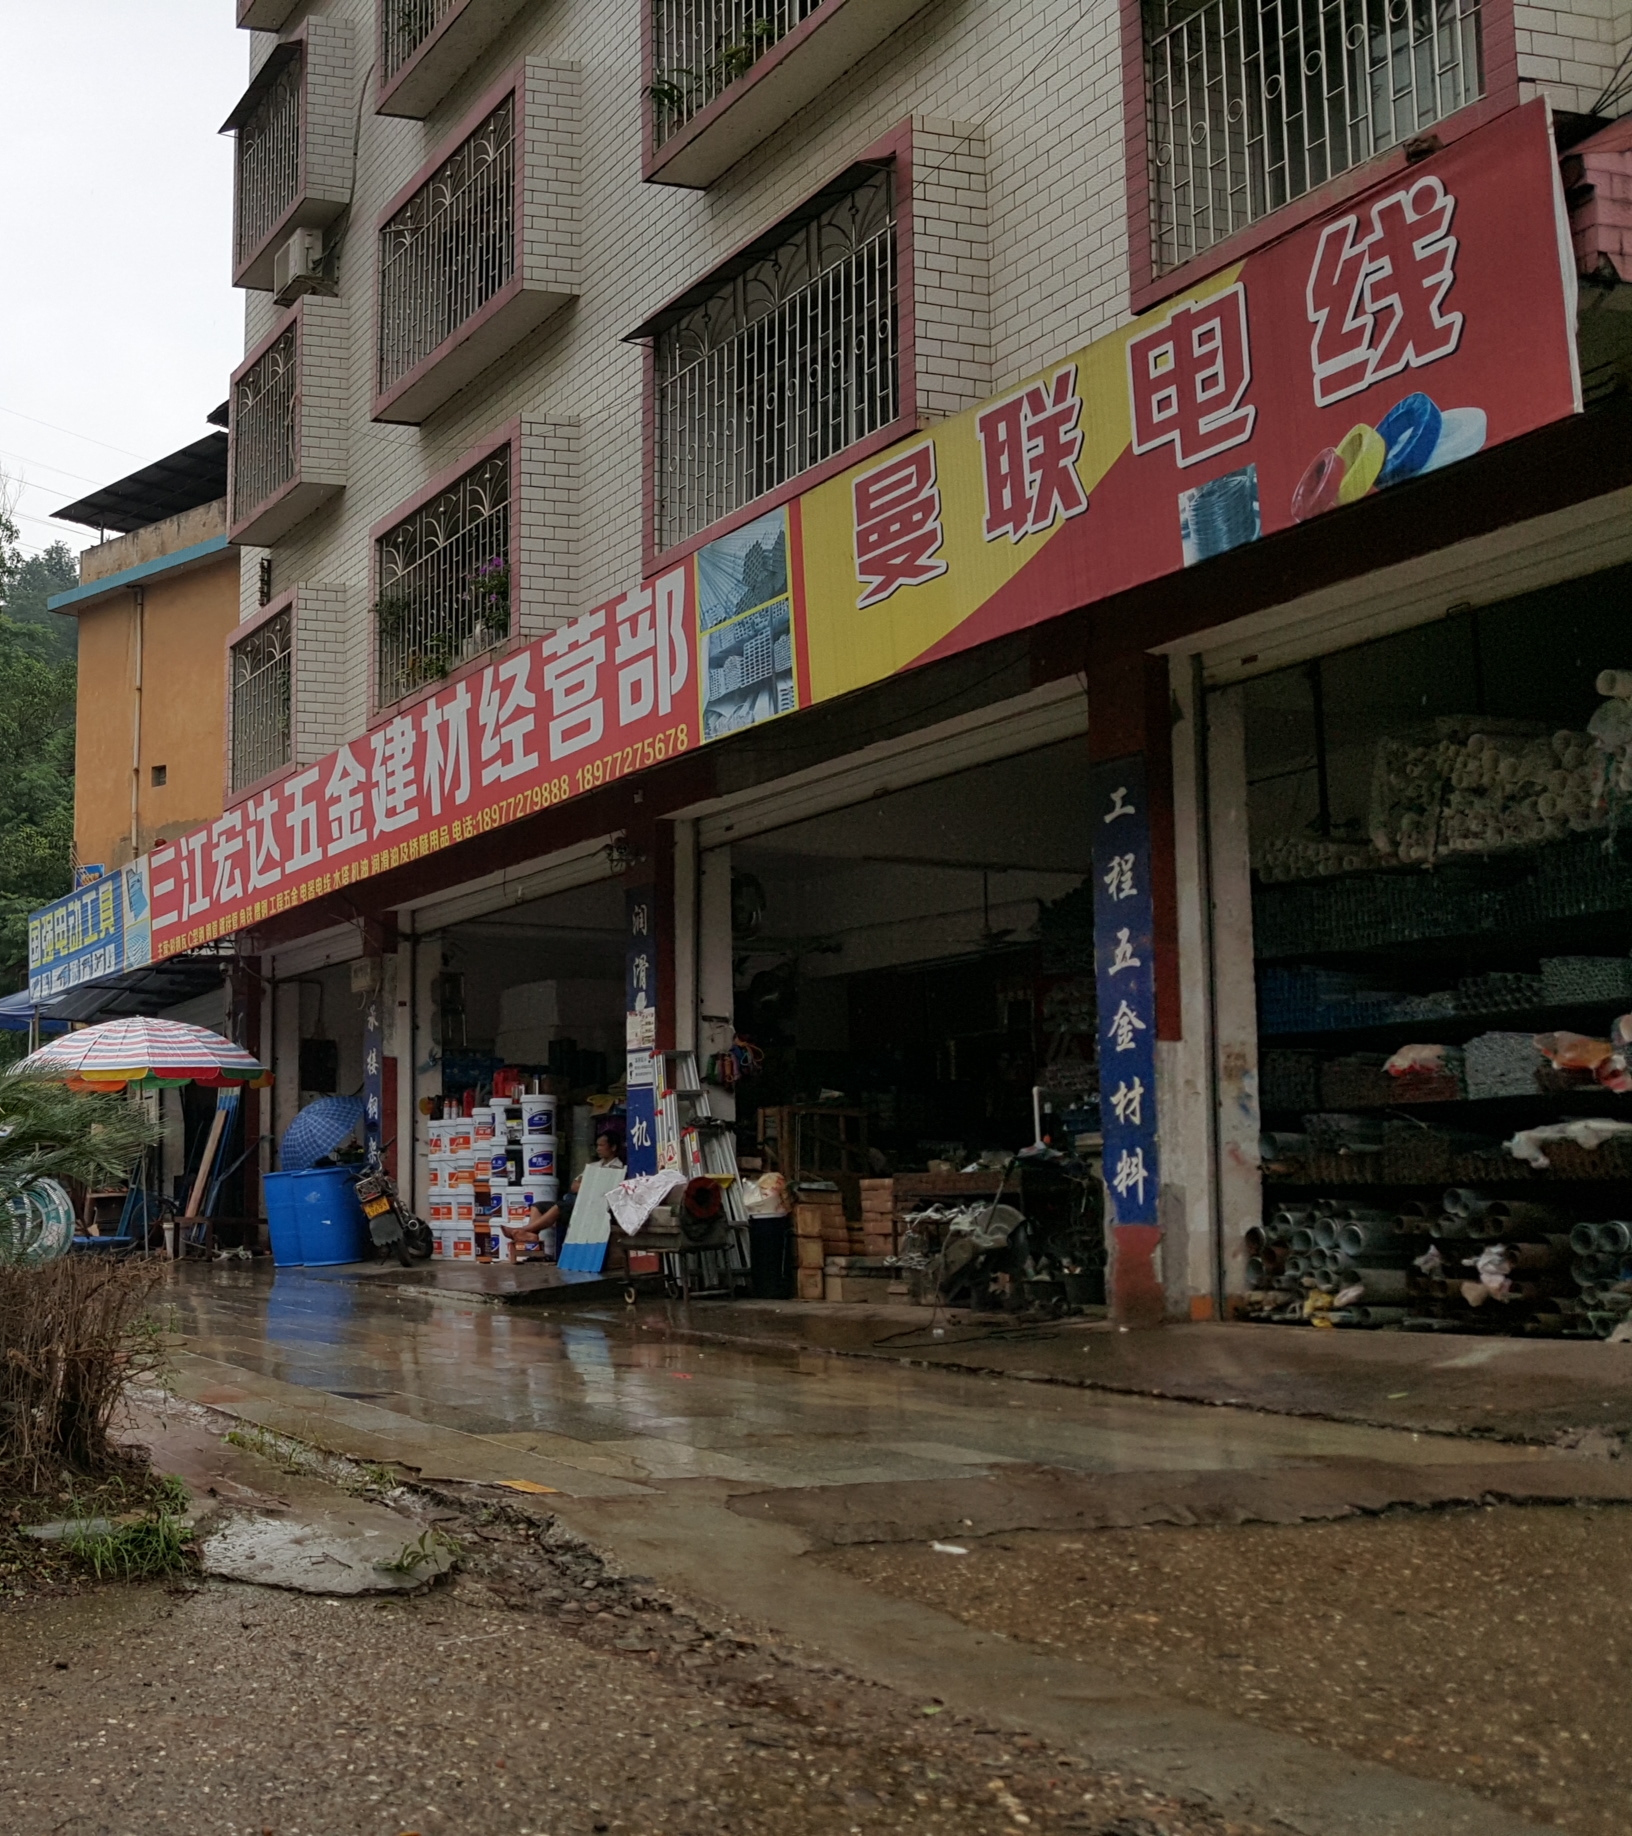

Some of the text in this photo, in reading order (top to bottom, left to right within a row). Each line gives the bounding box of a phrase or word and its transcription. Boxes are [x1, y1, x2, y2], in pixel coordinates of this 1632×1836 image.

[852, 175, 1464, 608] 曼联电线
[151, 565, 689, 930] 三江宏达五金建材经营部
[269, 887, 299, 913] 工程五金
[300, 873, 332, 902] 电器电线
[333, 866, 350, 889] 水塔
[351, 857, 369, 881] 机油
[575, 723, 689, 793] 18977275678
[1103, 786, 1148, 1206] 工程五金材料
